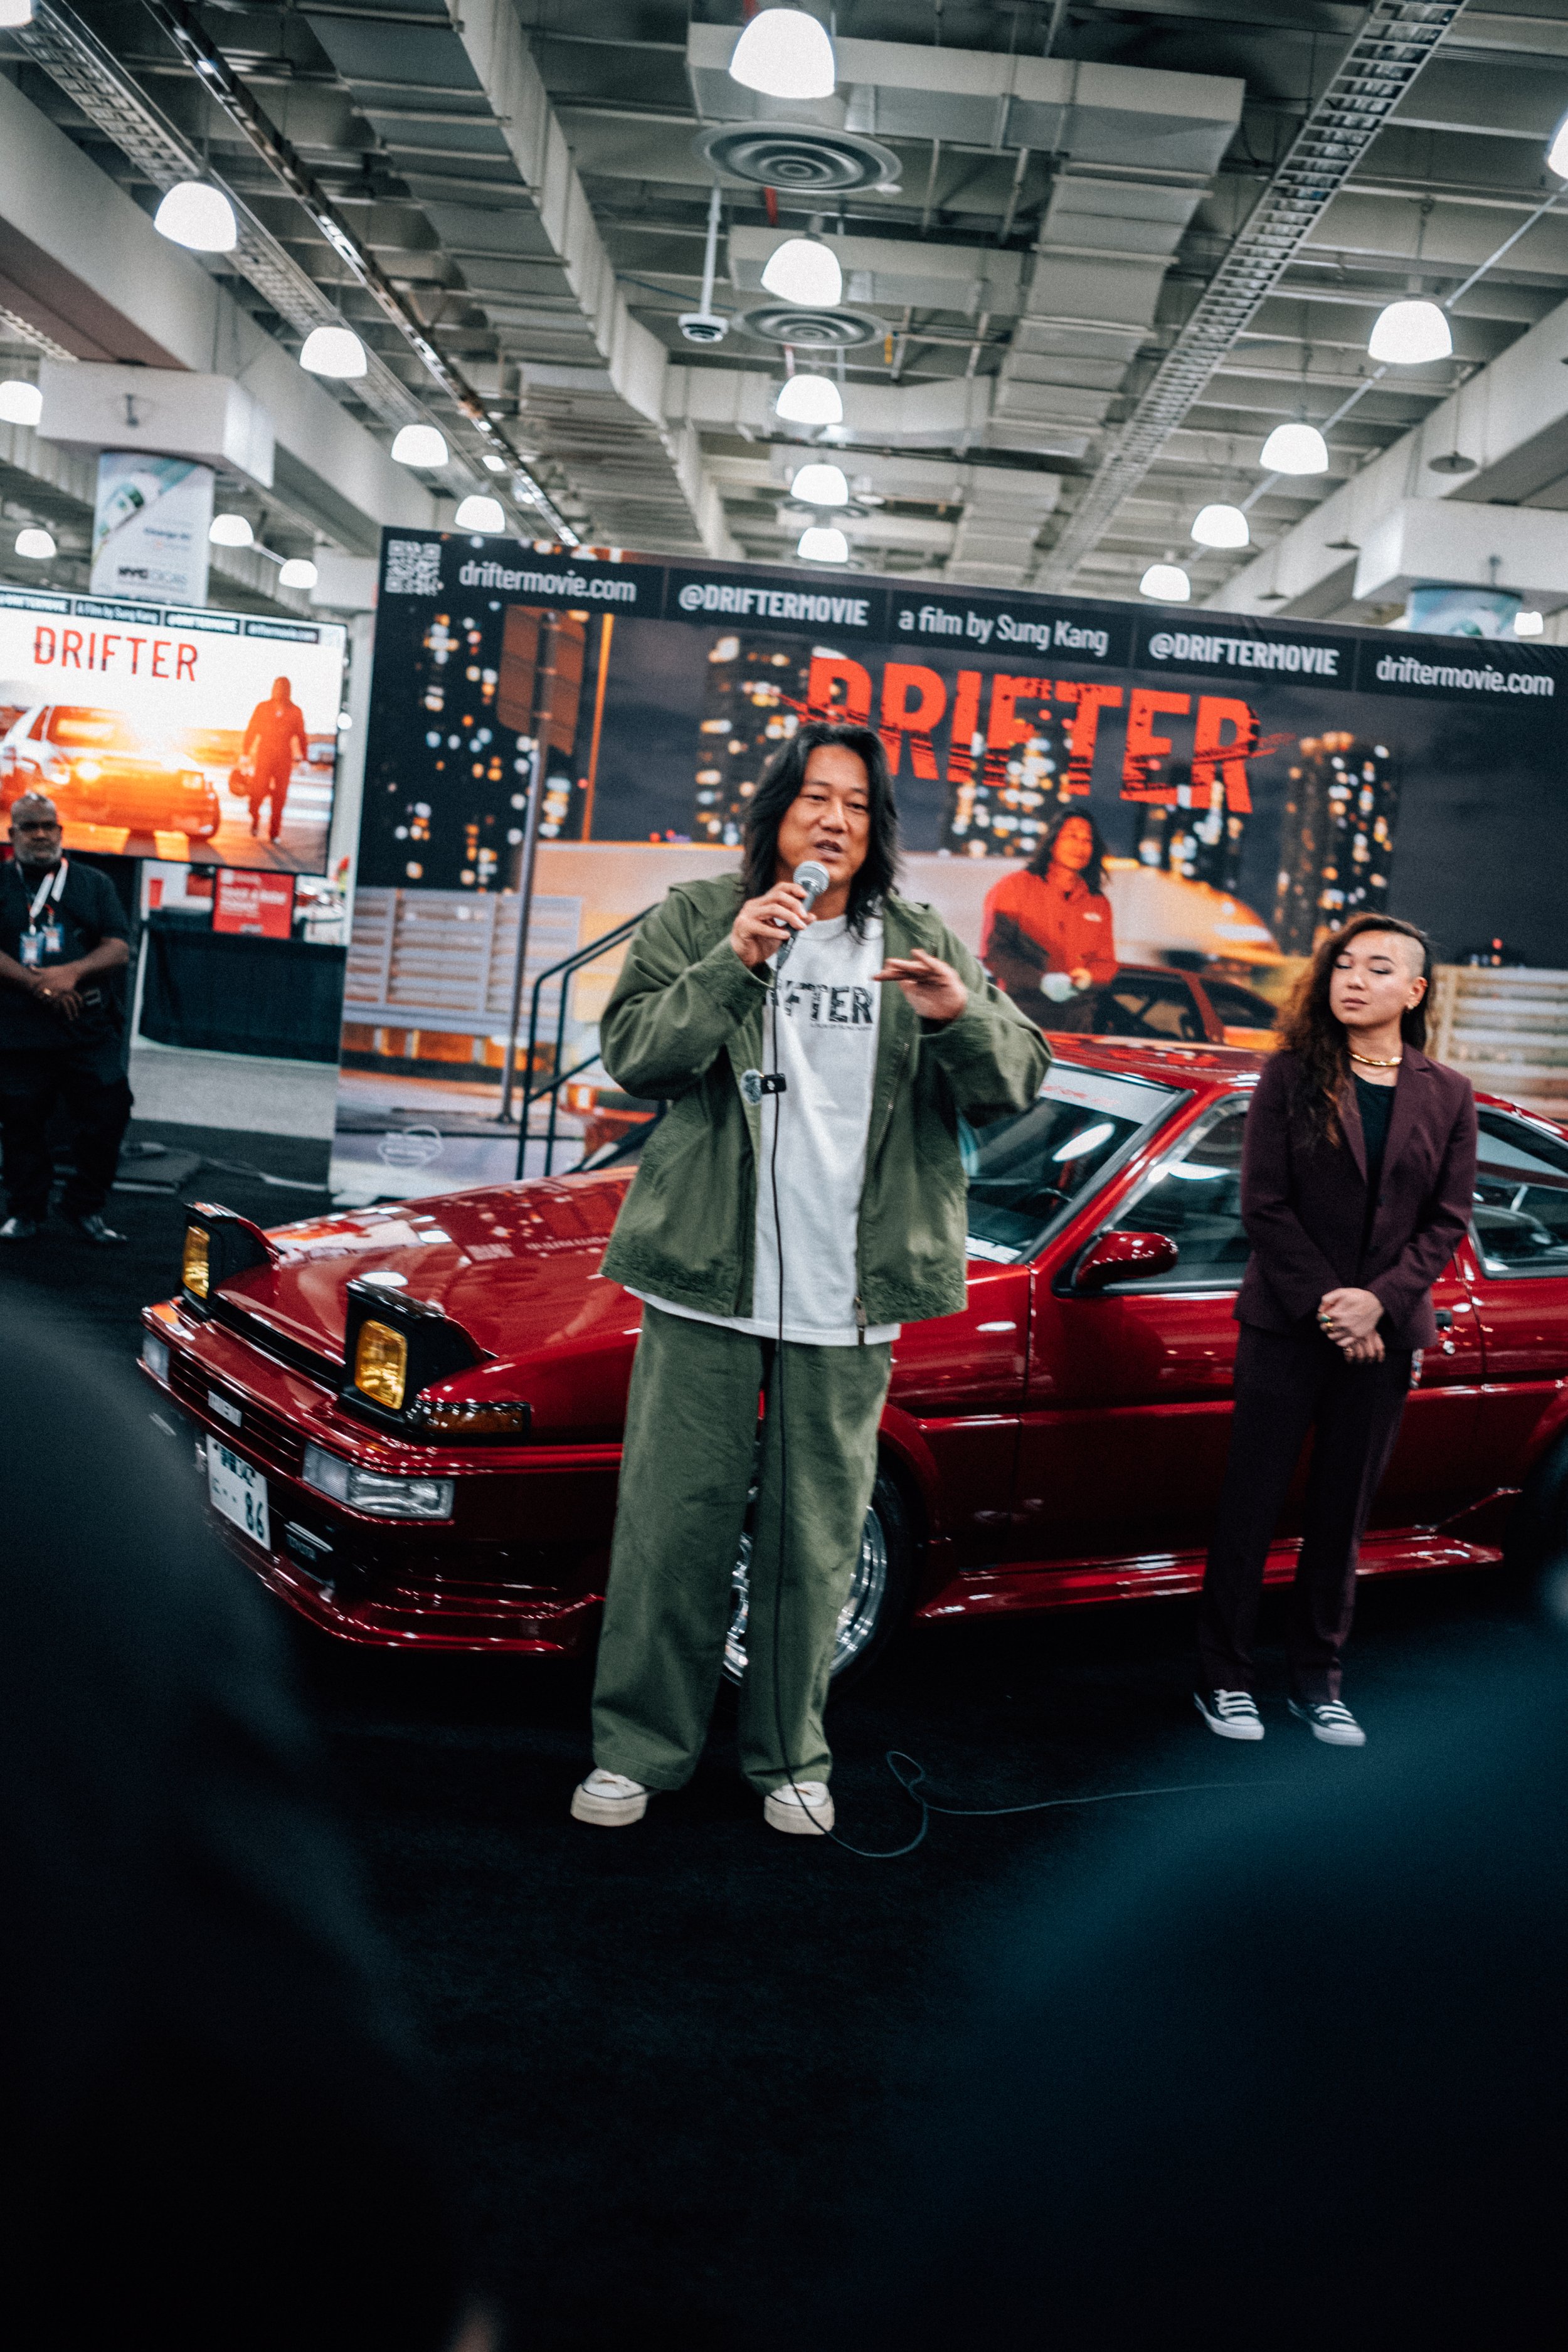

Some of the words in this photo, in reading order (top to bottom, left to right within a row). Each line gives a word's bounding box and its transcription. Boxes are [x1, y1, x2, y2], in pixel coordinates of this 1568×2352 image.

[458, 560, 636, 602] driftermovie.com
[678, 584, 871, 627] @DRIFTERMOVIE
[898, 610, 915, 630] a
[918, 605, 963, 636] film
[966, 610, 994, 645] by
[996, 614, 1051, 651] Sung
[1054, 620, 1109, 657] Kang
[34, 625, 198, 682] DRIFTER
[1148, 632, 1340, 675] @DRIFTERMOVIE
[1375, 654, 1555, 697] driftermovie.com
[803, 647, 1261, 812] DRIFTER
